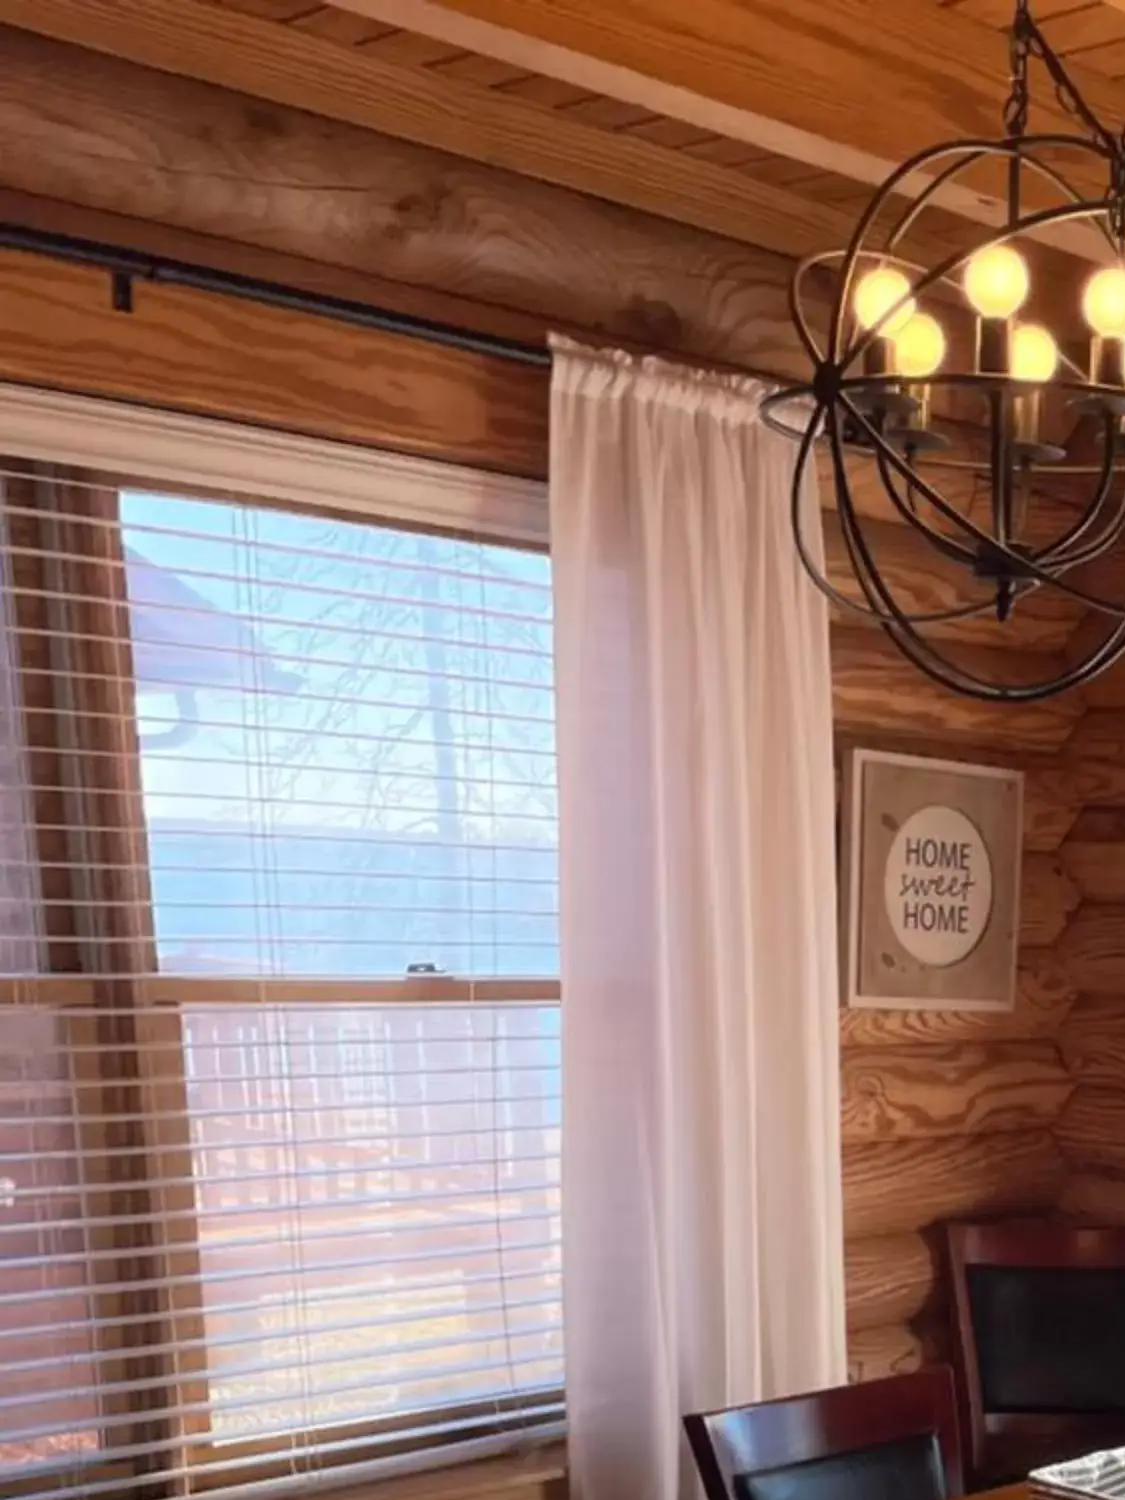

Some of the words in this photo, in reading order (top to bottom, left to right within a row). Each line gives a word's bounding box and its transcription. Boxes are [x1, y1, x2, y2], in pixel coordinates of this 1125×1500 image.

[905, 837, 972, 871] HOME
[899, 871, 976, 902] sweet
[903, 901, 969, 934] HOME
